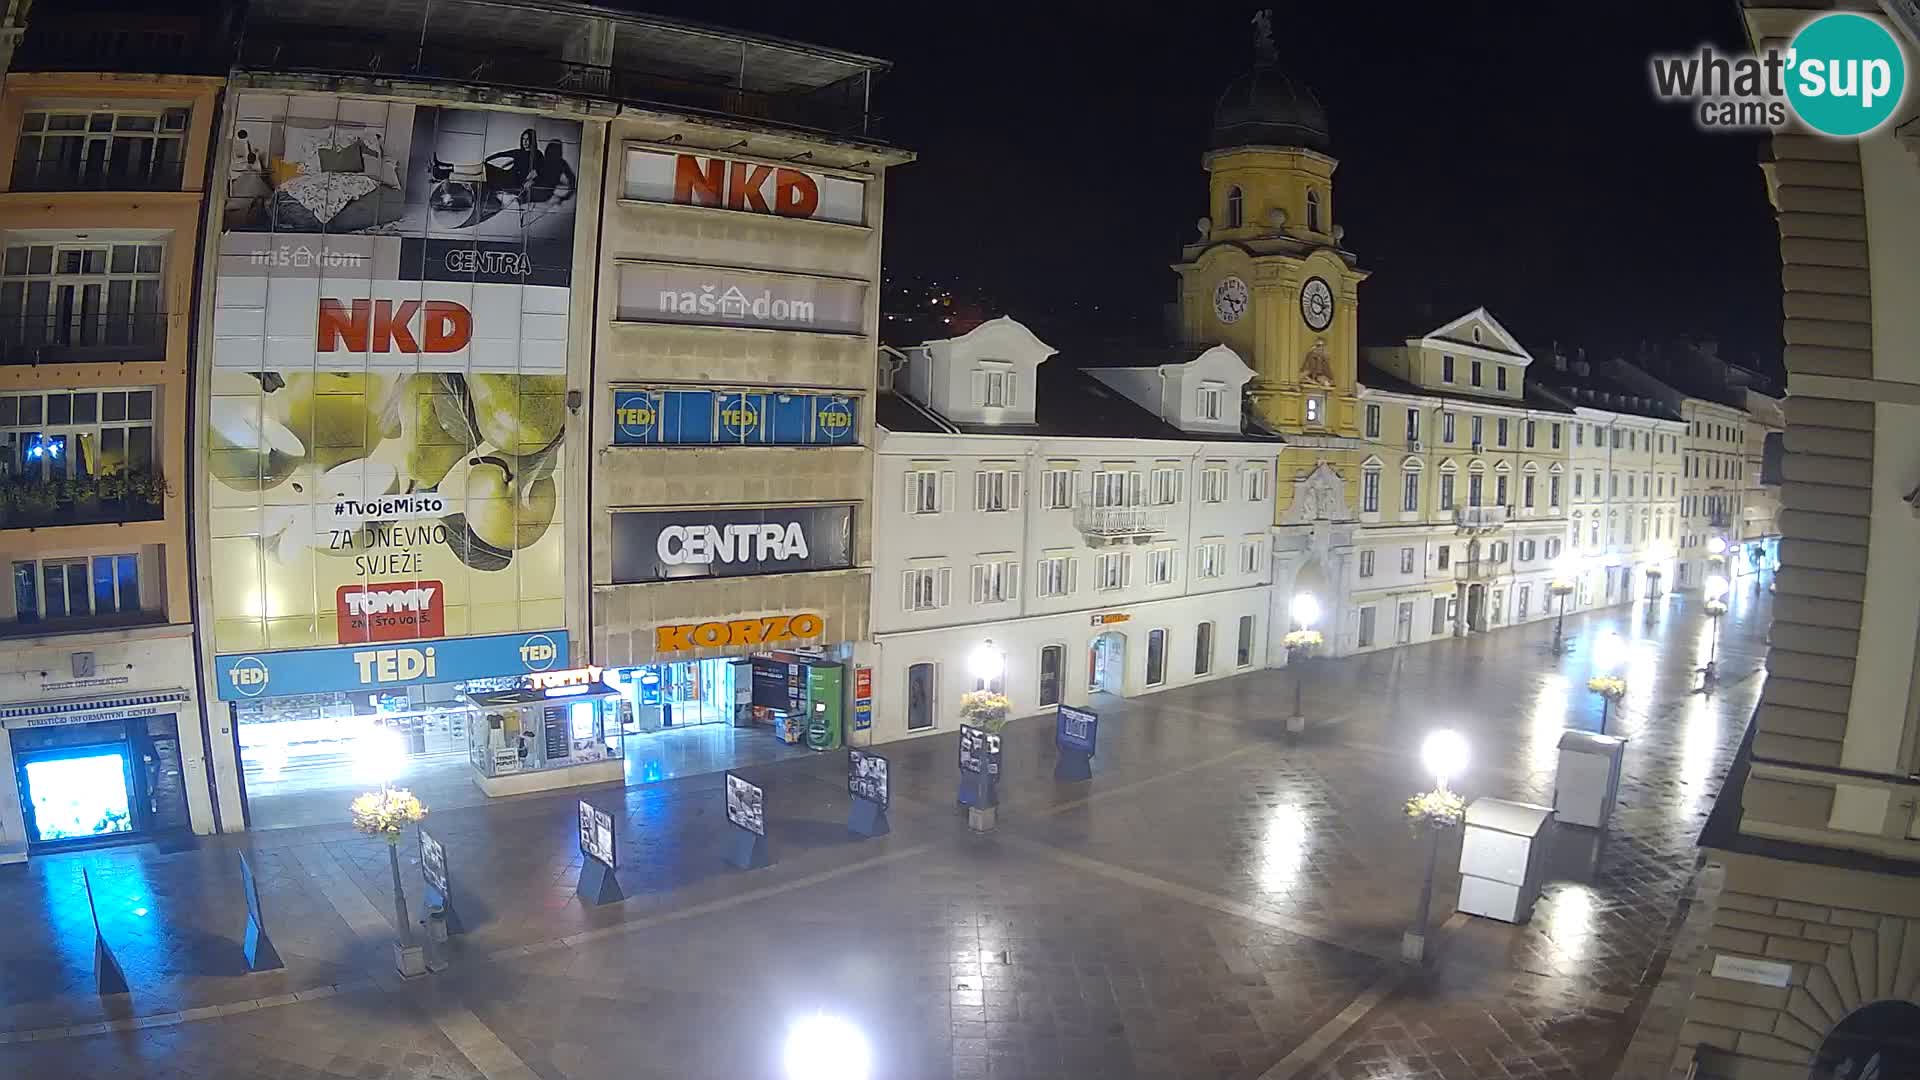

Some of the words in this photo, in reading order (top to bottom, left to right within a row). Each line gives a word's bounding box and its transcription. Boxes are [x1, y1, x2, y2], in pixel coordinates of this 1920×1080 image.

[674, 154, 819, 218] NKD
[250, 246, 291, 267] naš
[315, 246, 361, 268] dom
[445, 249, 531, 277] CENTRA
[659, 284, 716, 316] naš
[752, 290, 815, 323] dom
[317, 298, 474, 354] NKD
[334, 498, 443, 517] #TvojeMisto
[329, 530, 354, 550] ZA
[362, 524, 447, 548] DNEVNO
[656, 522, 809, 566] CENTRA
[355, 548, 424, 576] SVJEŽE
[345, 588, 436, 615] TOMMY
[656, 613, 824, 653] KORZO
[354, 647, 436, 684] TEDi
